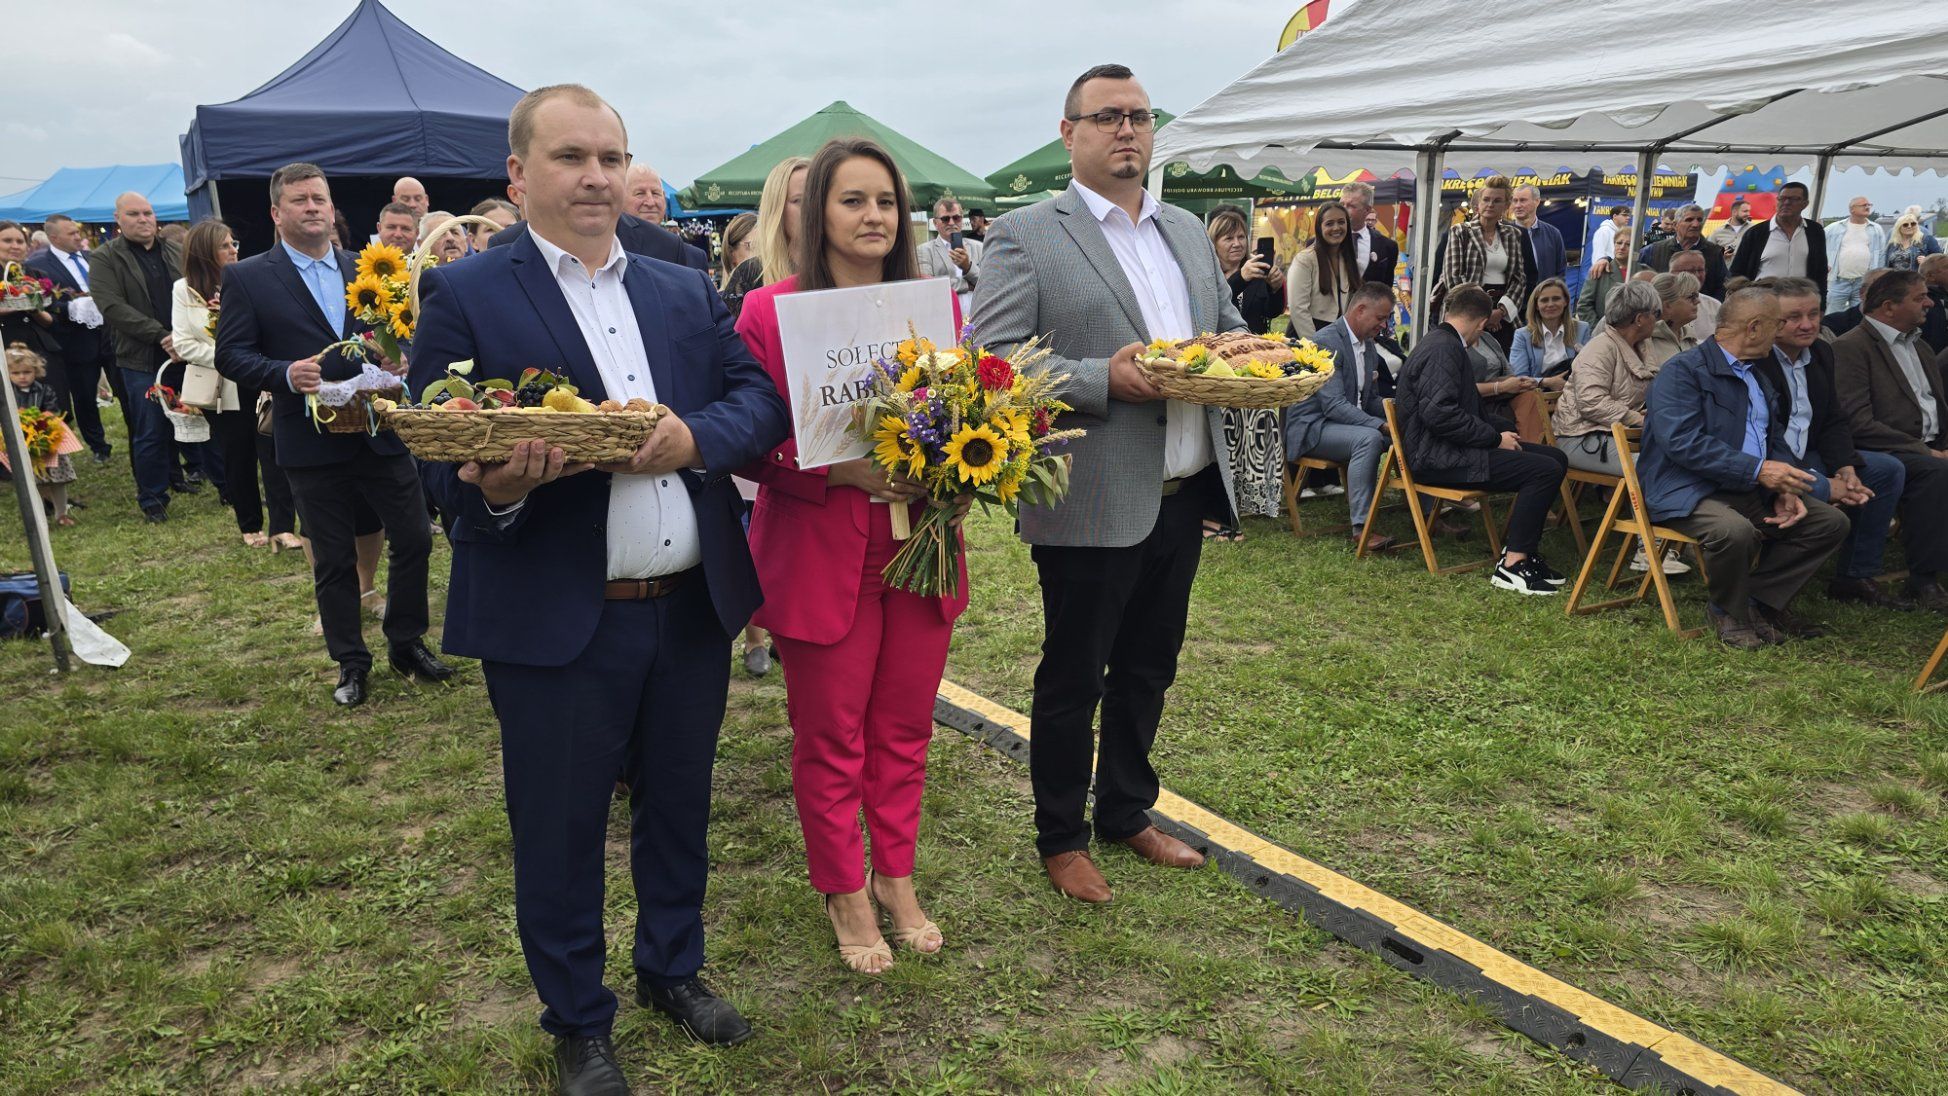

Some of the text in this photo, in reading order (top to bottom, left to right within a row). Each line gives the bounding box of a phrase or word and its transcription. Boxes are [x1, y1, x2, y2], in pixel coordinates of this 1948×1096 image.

[1510, 173, 1571, 187] IEMNIAK
[1652, 175, 1688, 188] IEMNIAK
[826, 336, 929, 369] SOŁECT
